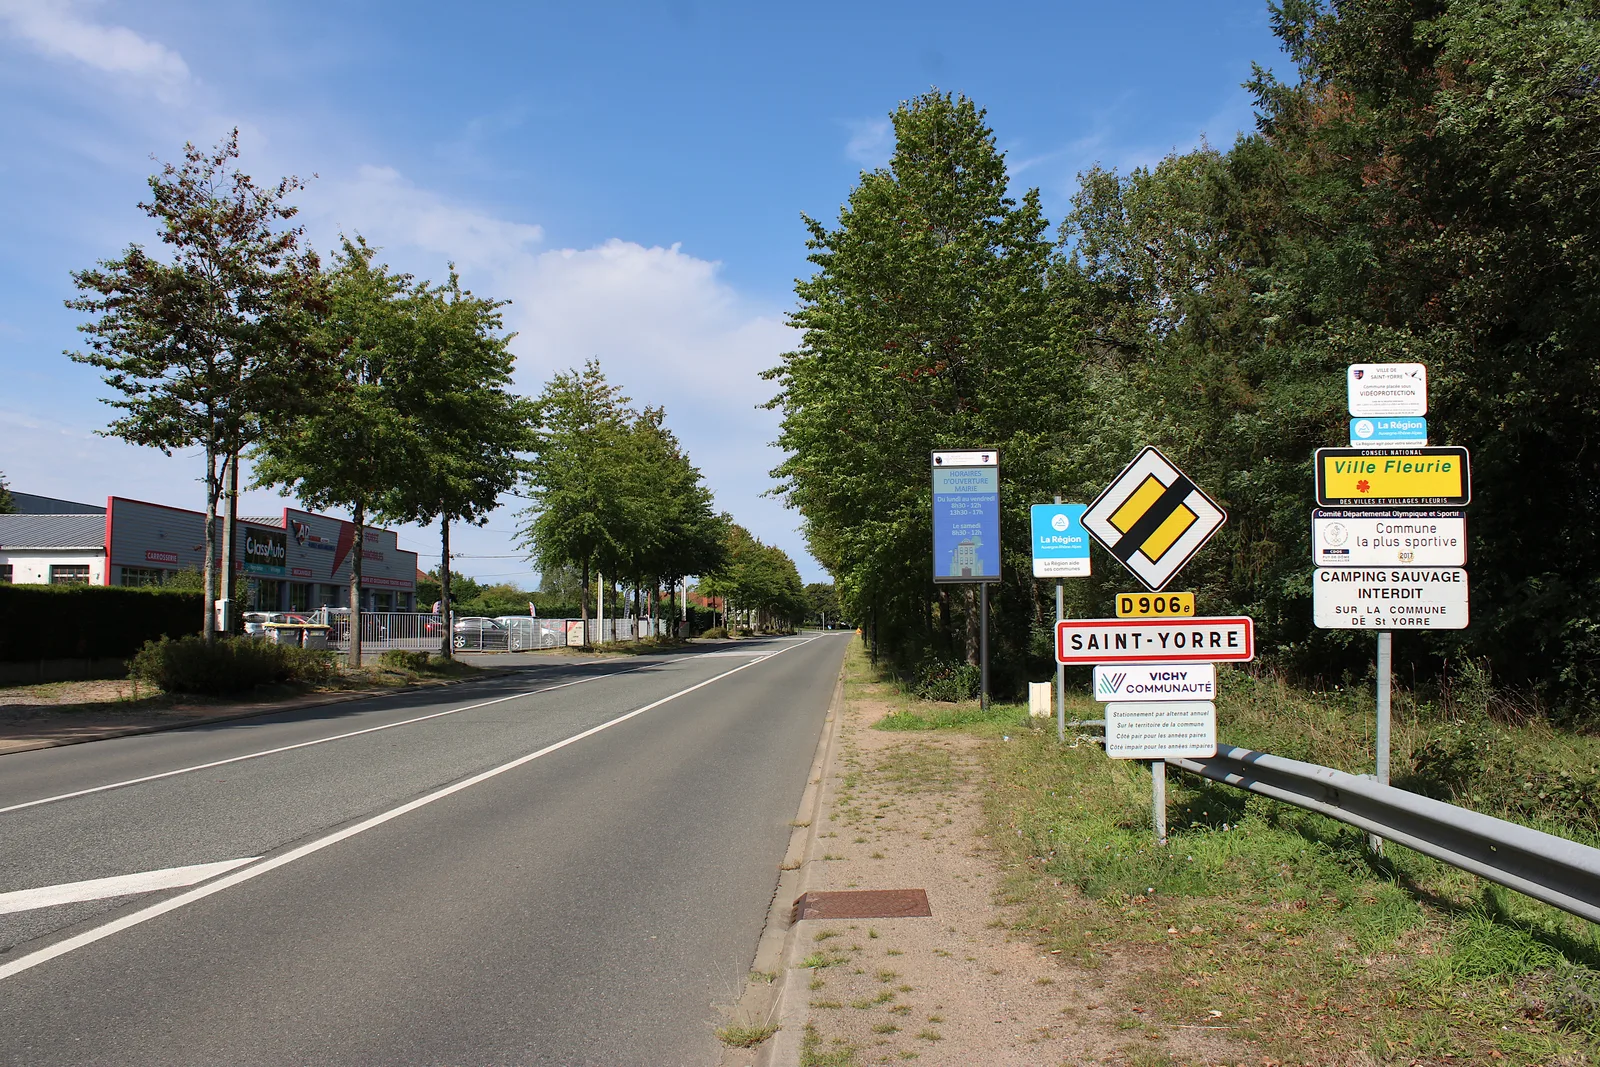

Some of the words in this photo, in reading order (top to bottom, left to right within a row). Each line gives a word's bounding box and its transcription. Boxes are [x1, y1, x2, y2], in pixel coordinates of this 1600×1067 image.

[1390, 421, 1422, 430] Région
[1334, 461, 1376, 474] Ville
[1384, 460, 1452, 473] Fleurie
[1343, 510, 1391, 518] Départemental
[1392, 510, 1428, 518] Olympique
[1376, 522, 1437, 534] Commune
[1052, 535, 1082, 544] Région
[1357, 536, 1368, 547] la
[1373, 536, 1400, 549] plus
[1405, 536, 1457, 549] sportive
[246, 536, 285, 559] ClassAuto
[147, 552, 177, 562] CARROSSERIE
[1320, 572, 1386, 582] CAMPING
[1391, 571, 1461, 582] SAUVAGE
[1358, 588, 1423, 598] INTERDIT
[1335, 606, 1358, 614] SUR
[1367, 606, 1381, 614] LA
[1389, 606, 1446, 614] COMMUNE
[1352, 618, 1366, 626] DE
[1392, 617, 1430, 625] YORRE
[1071, 631, 1239, 650] SAINT-YORRE
[1149, 672, 1188, 681] VICHY
[1126, 681, 1212, 694] COMMUNAUTÉ
